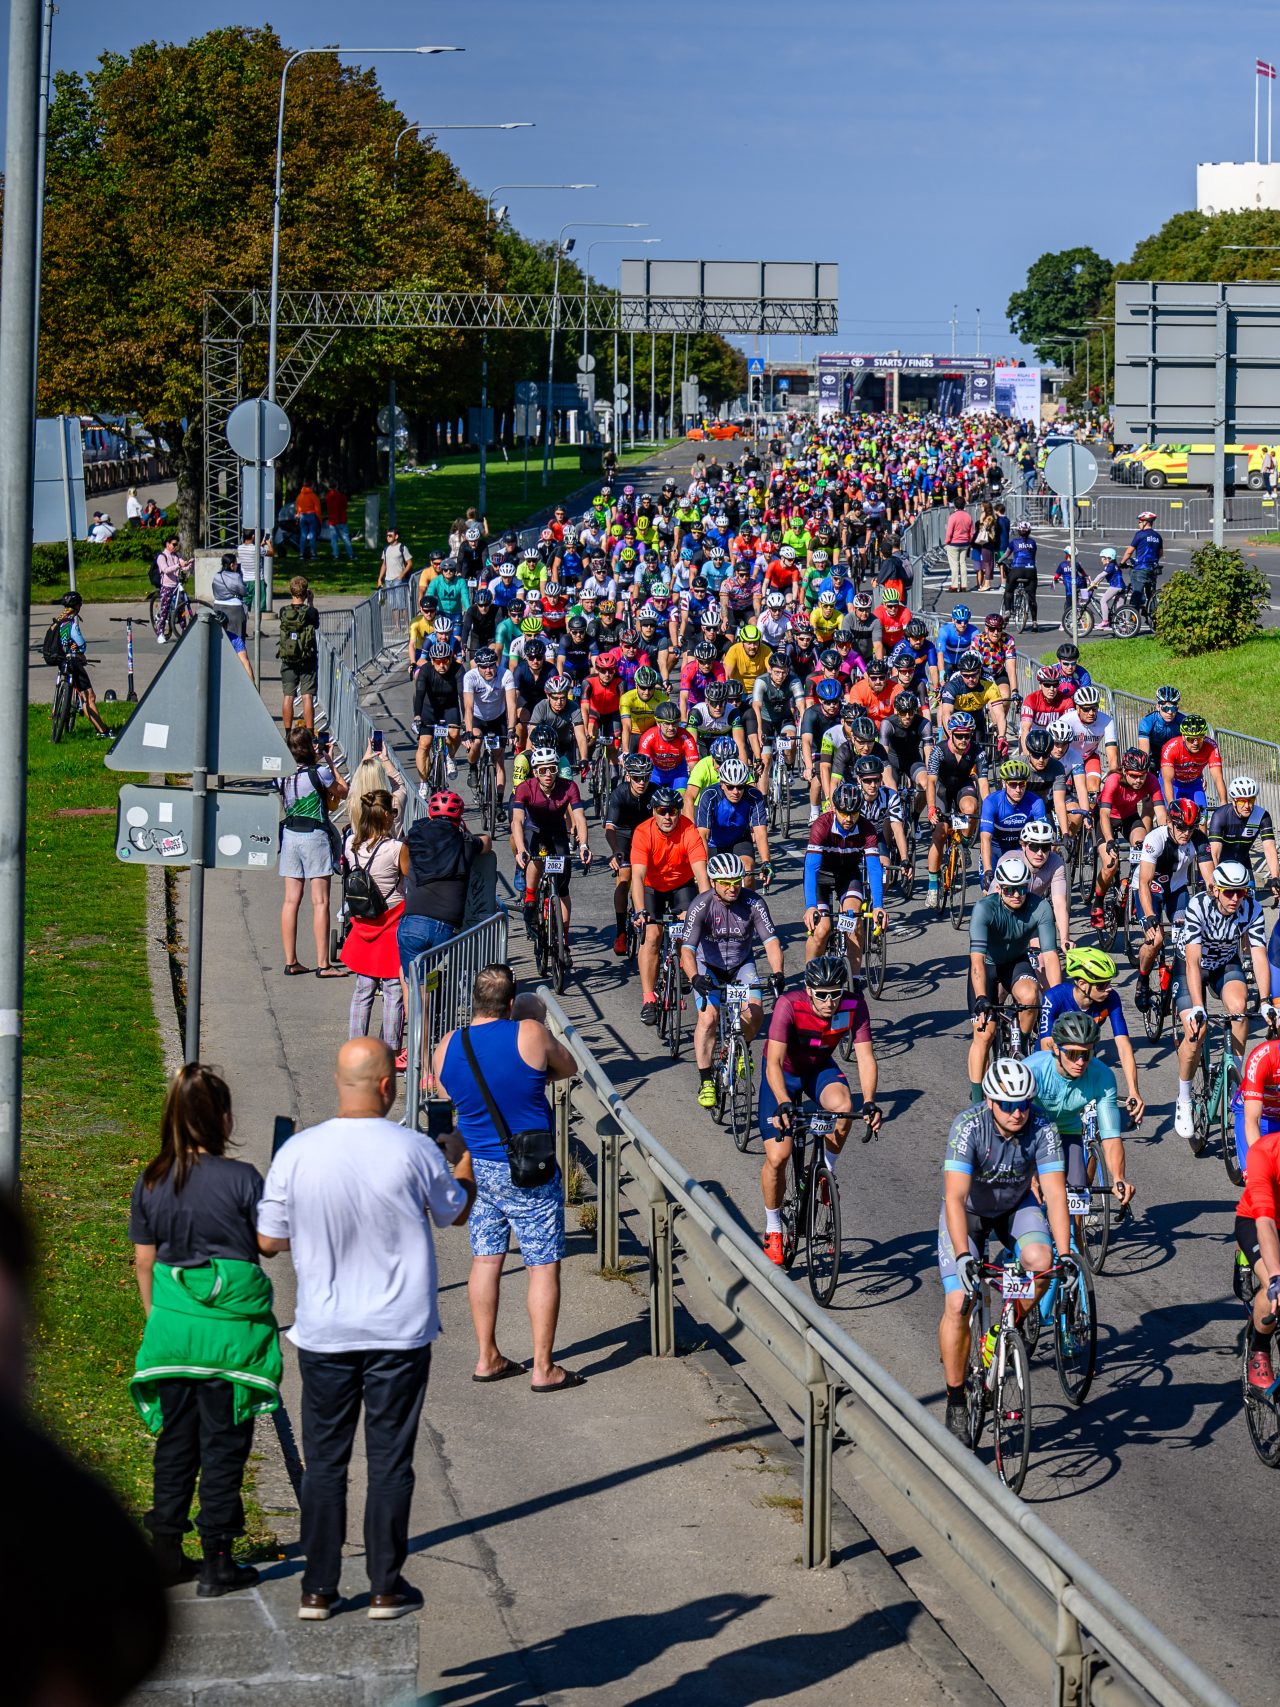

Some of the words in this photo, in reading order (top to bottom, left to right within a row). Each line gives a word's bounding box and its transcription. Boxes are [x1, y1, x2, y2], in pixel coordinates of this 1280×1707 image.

[874, 358, 903, 367] STARTS
[908, 357, 934, 368] FINIŠS
[1040, 996, 1053, 1034] Atom
